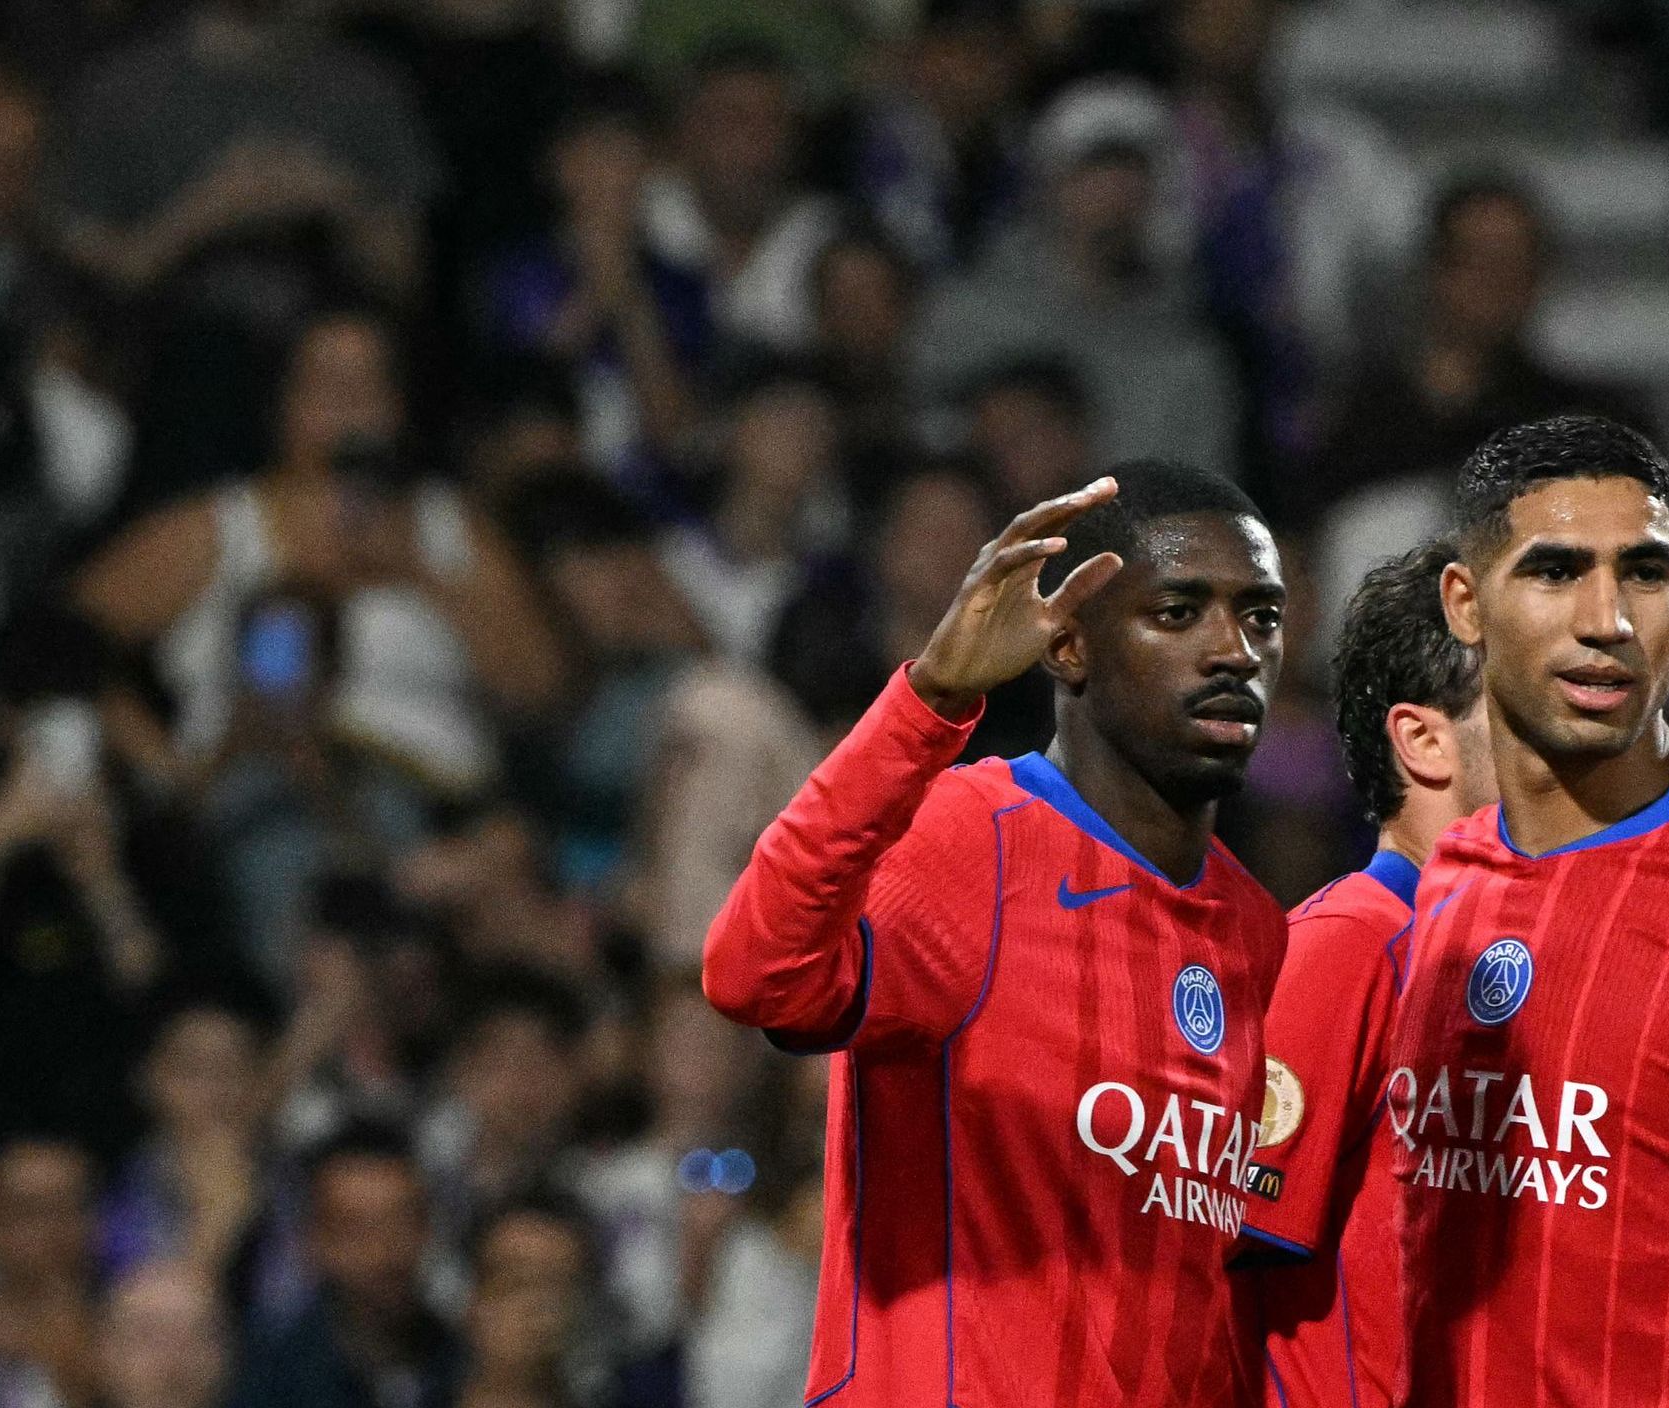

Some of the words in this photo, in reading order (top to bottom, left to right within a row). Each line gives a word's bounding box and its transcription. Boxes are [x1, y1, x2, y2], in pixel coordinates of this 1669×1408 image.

[1180, 970, 1215, 994] PARIS
[1485, 943, 1526, 965] PARIS
[1386, 1064, 1612, 1158] QATAR
[1140, 1172, 1246, 1240] AIRWAY
[1412, 1144, 1610, 1210] AIRWAYS
